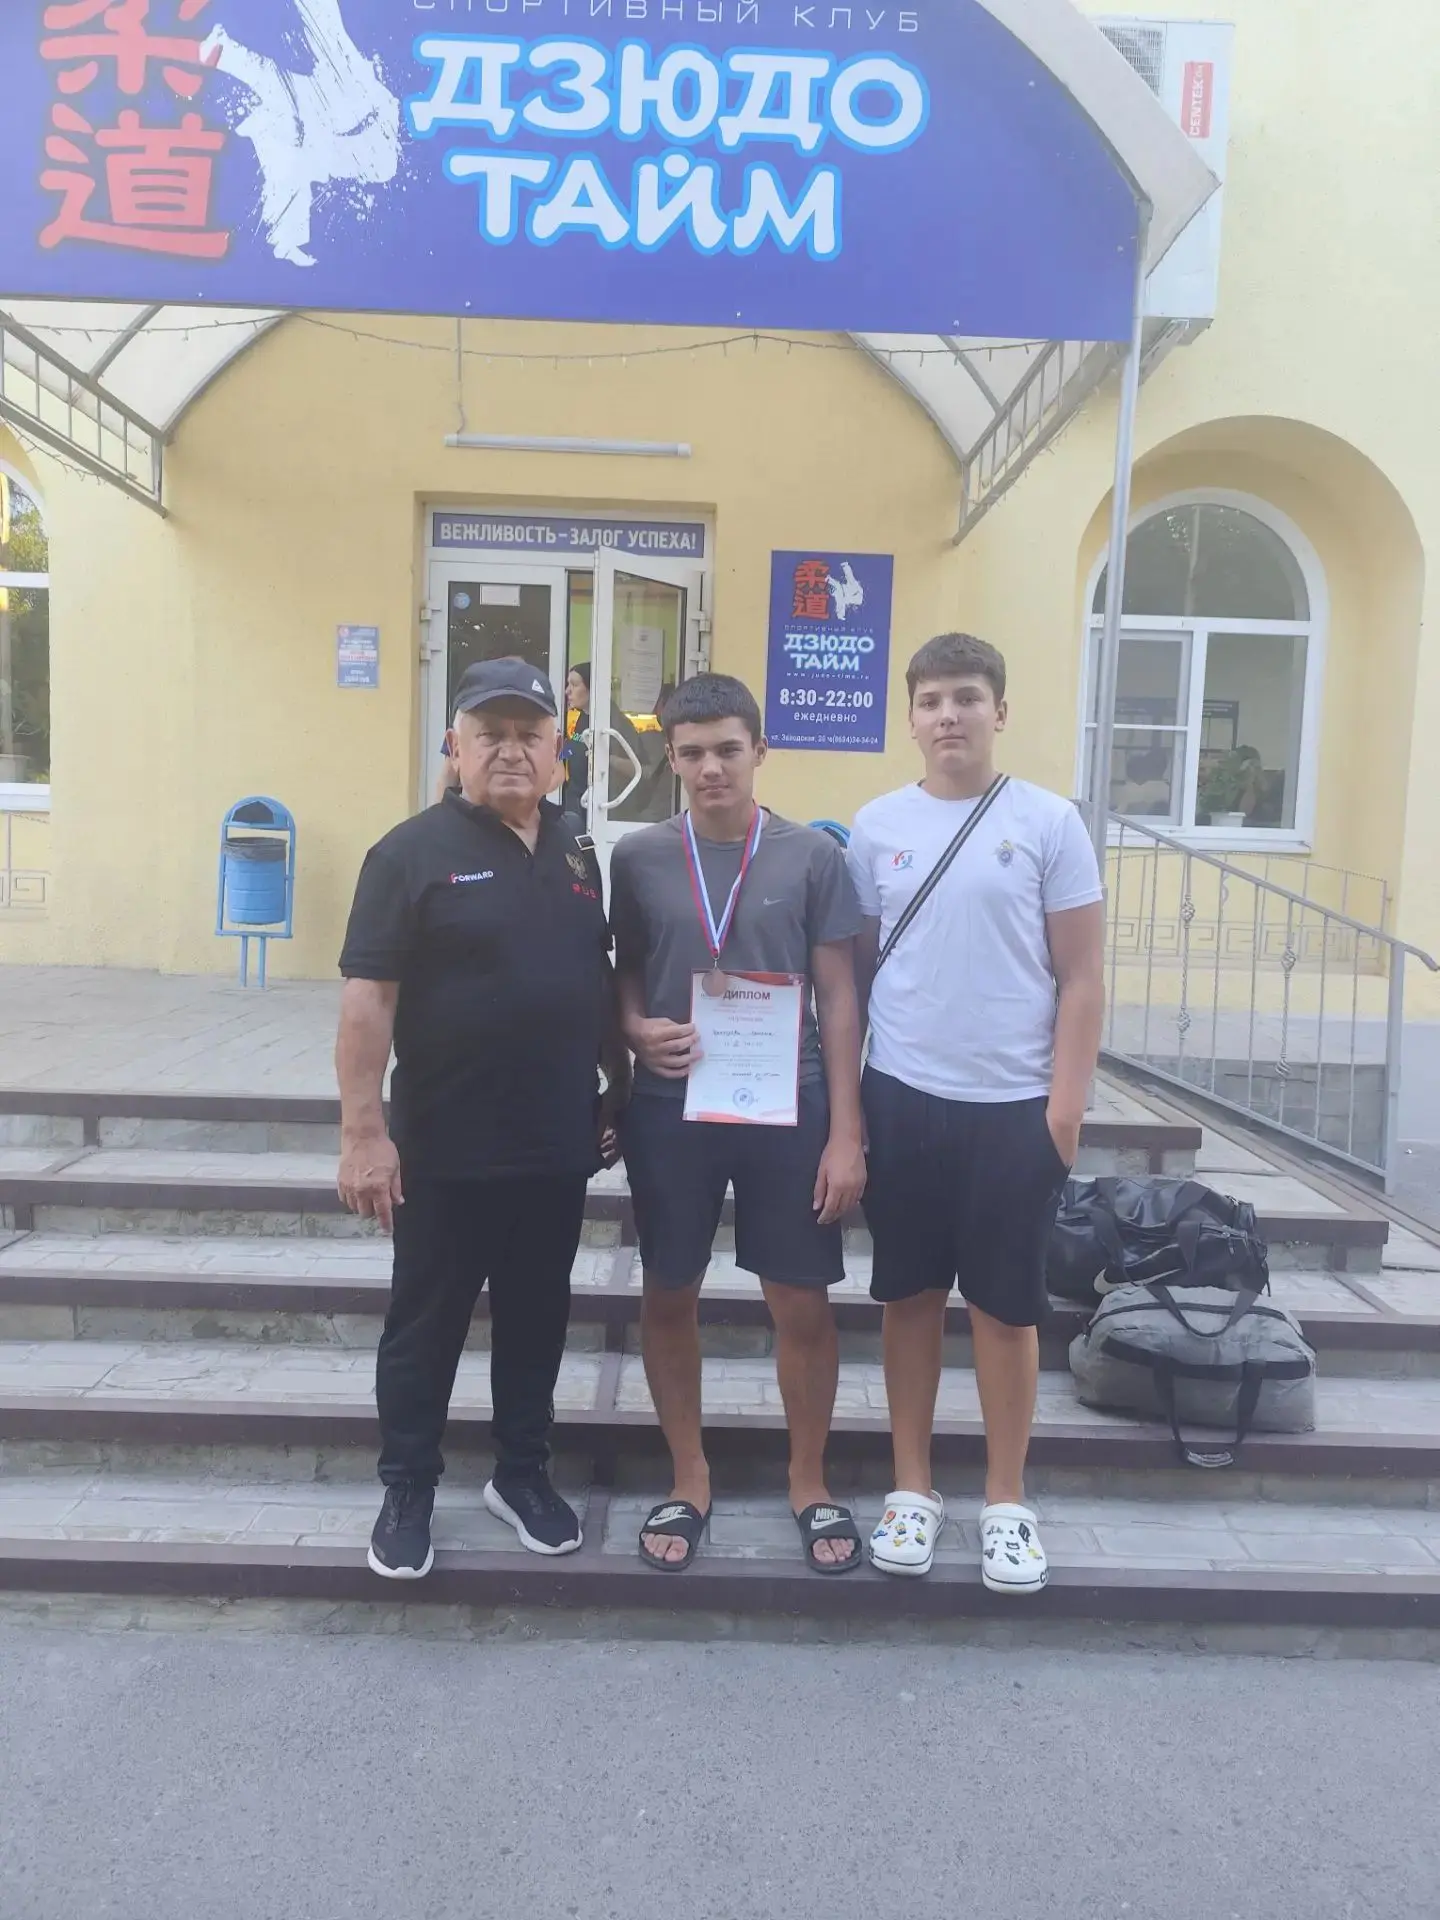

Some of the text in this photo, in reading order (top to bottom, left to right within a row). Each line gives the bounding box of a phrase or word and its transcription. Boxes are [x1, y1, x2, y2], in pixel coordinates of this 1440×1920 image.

[794, 5, 919, 33] КЛУБ
[409, 38, 924, 150] ДЗЮДО
[1189, 77, 1204, 136] CENTEK
[449, 154, 836, 255] ТАЙМ
[627, 530, 697, 550] УСПЕХА!
[783, 633, 875, 654] ДЗЮДО
[790, 652, 860, 672] ТАЙМ
[779, 687, 874, 709] 8:30-22:00
[793, 711, 858, 723] ежедневно
[450, 870, 494, 884] FORWARD
[722, 989, 771, 1001] ДИПЛОМ
[815, 1507, 840, 1520] NIKE
